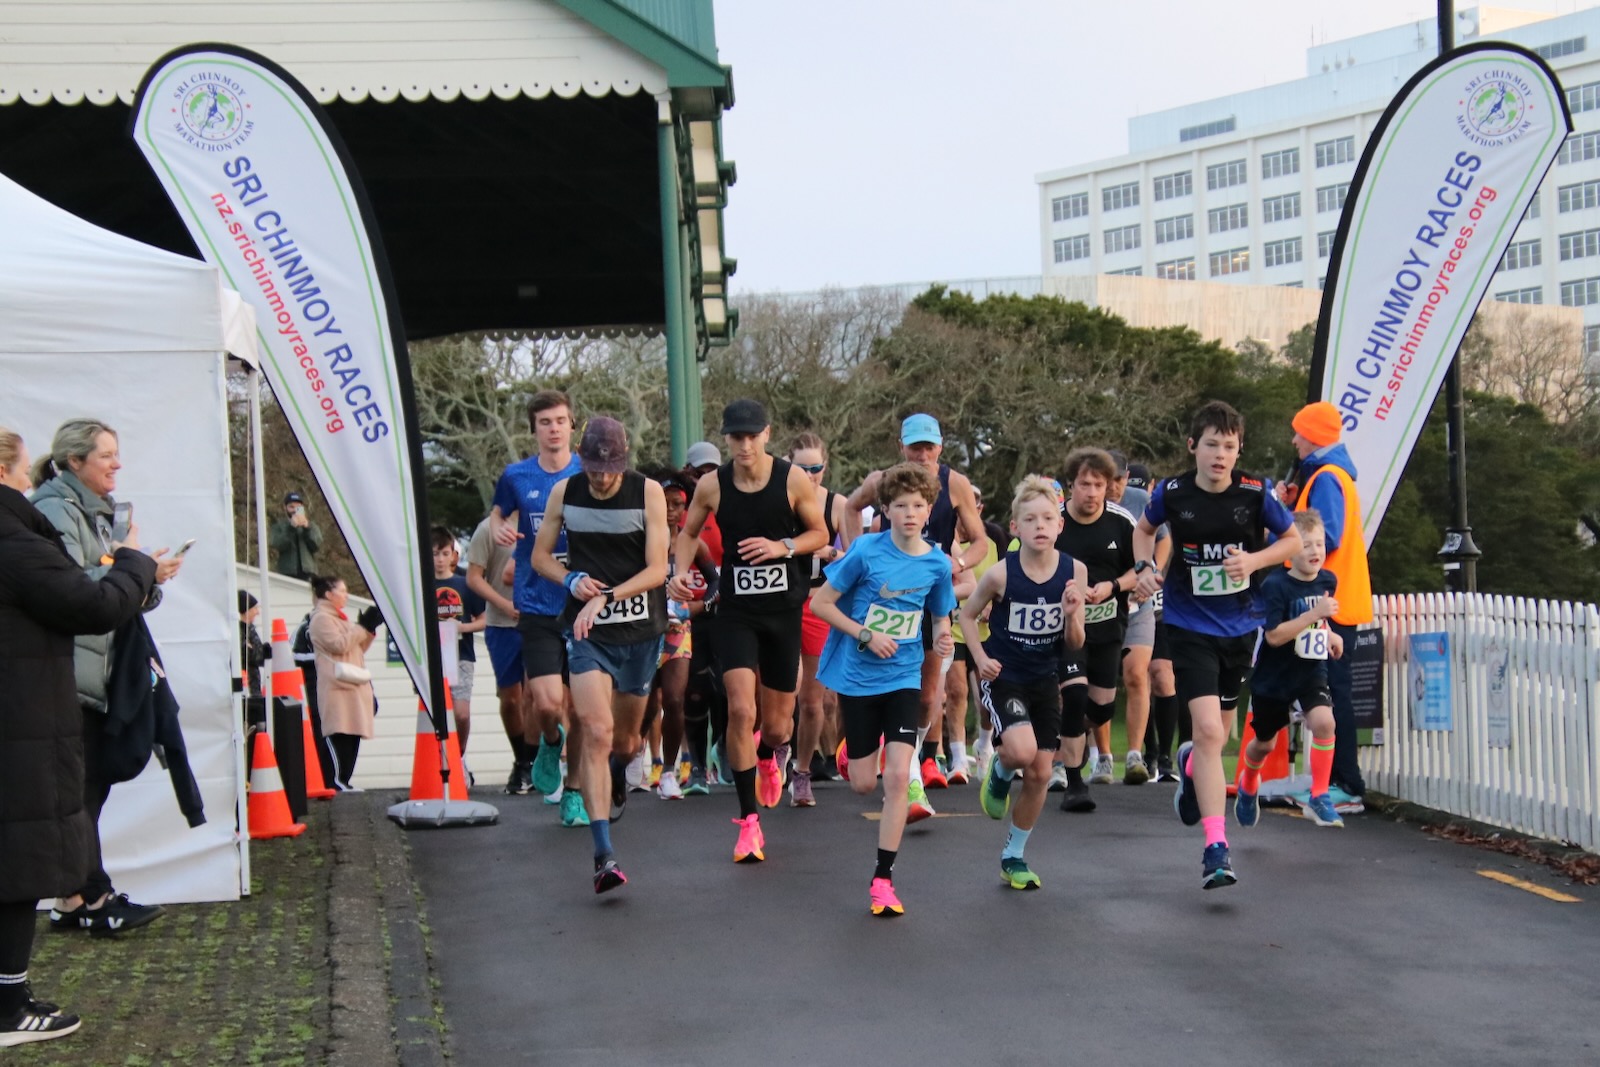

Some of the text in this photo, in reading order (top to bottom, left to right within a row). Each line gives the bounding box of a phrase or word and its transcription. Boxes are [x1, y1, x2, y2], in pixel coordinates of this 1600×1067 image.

[173, 72, 246, 99] SRI CHINMOY
[1465, 70, 1532, 96] SRI CHINMOY
[175, 120, 254, 152] MARATHON TEAM
[1457, 115, 1531, 147] MARATHON TEAM
[223, 156, 389, 443] SRI CHINMOY RACES
[1339, 151, 1482, 431] SRI CHINMOY RACES
[1374, 185, 1497, 421] nz.srichinmoyraces.org
[211, 192, 345, 434] nz.srichinmoyraces.org
[737, 567, 784, 590] 652
[868, 609, 915, 636] 221
[1015, 607, 1061, 631] 183
[1085, 602, 1114, 621] 228
[1301, 631, 1325, 655] 18
